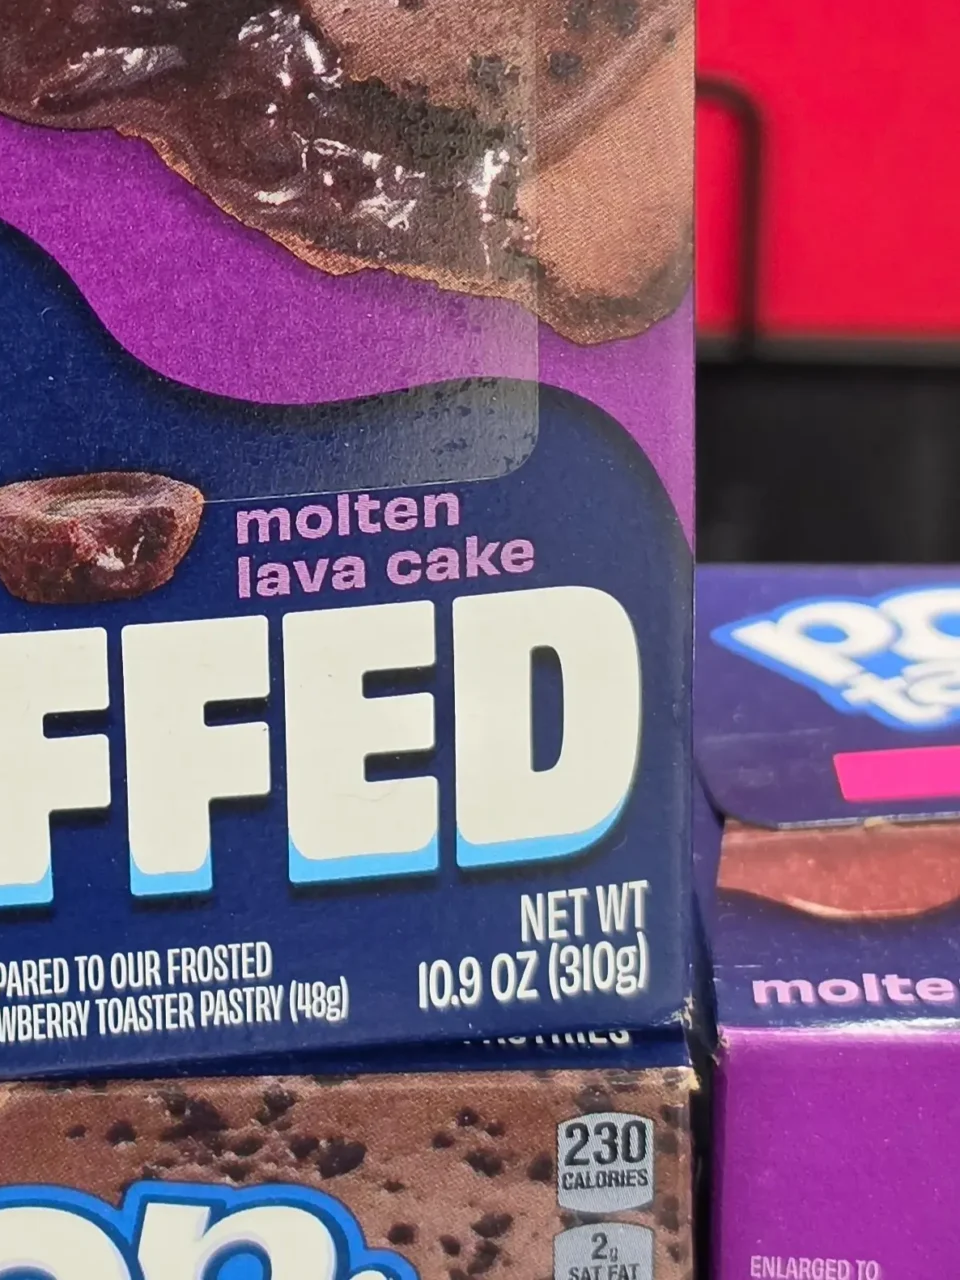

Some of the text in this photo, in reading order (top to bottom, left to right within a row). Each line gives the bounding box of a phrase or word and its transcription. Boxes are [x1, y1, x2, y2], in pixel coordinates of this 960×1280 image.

[236, 491, 460, 545] molten
[237, 535, 535, 598] lava cake
[520, 879, 649, 943] NET WT
[75, 954, 105, 993] TO
[110, 950, 161, 989] OUR
[167, 941, 273, 985] FROSTED
[418, 931, 648, 1009] 10.9 OZ (310g)
[752, 972, 960, 1006] molte
[95, 990, 194, 1036] TOASTER
[200, 984, 284, 1028] PASTRY
[289, 976, 350, 1022] (48g)
[564, 1120, 648, 1166] 230
[561, 1168, 649, 1191] CALORIES
[750, 1255, 880, 1280] ENLARGED TO
